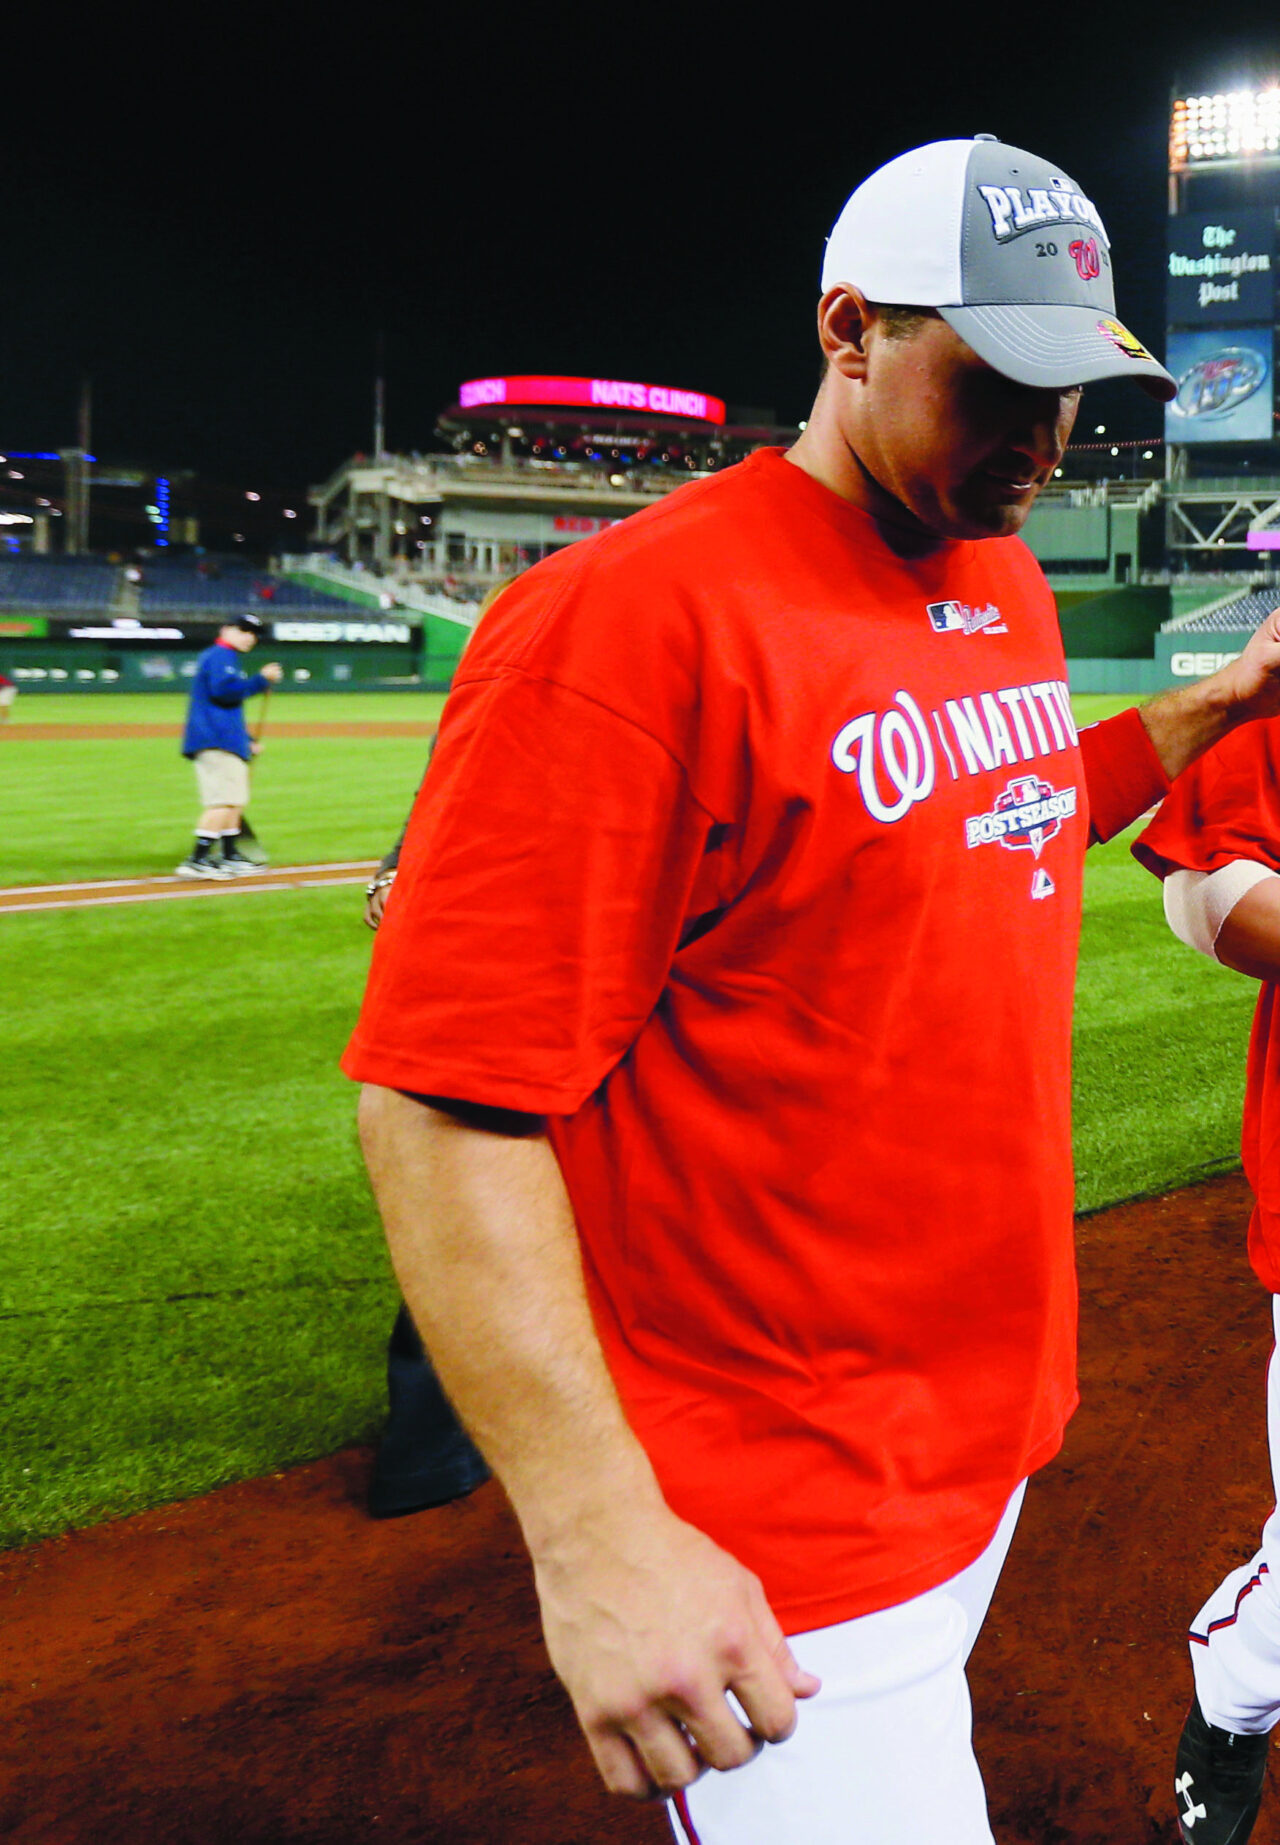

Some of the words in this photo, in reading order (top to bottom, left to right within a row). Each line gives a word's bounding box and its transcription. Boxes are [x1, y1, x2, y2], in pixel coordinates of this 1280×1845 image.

[977, 184, 1111, 249] PLAYO
[1202, 225, 1237, 248] The
[1034, 241, 1058, 257] 20
[1068, 237, 1100, 280] W
[1168, 251, 1271, 278] Washington
[1198, 281, 1239, 308] Post
[591, 379, 647, 408] NATS
[648, 386, 707, 418] CLINCH
[831, 689, 935, 824] W
